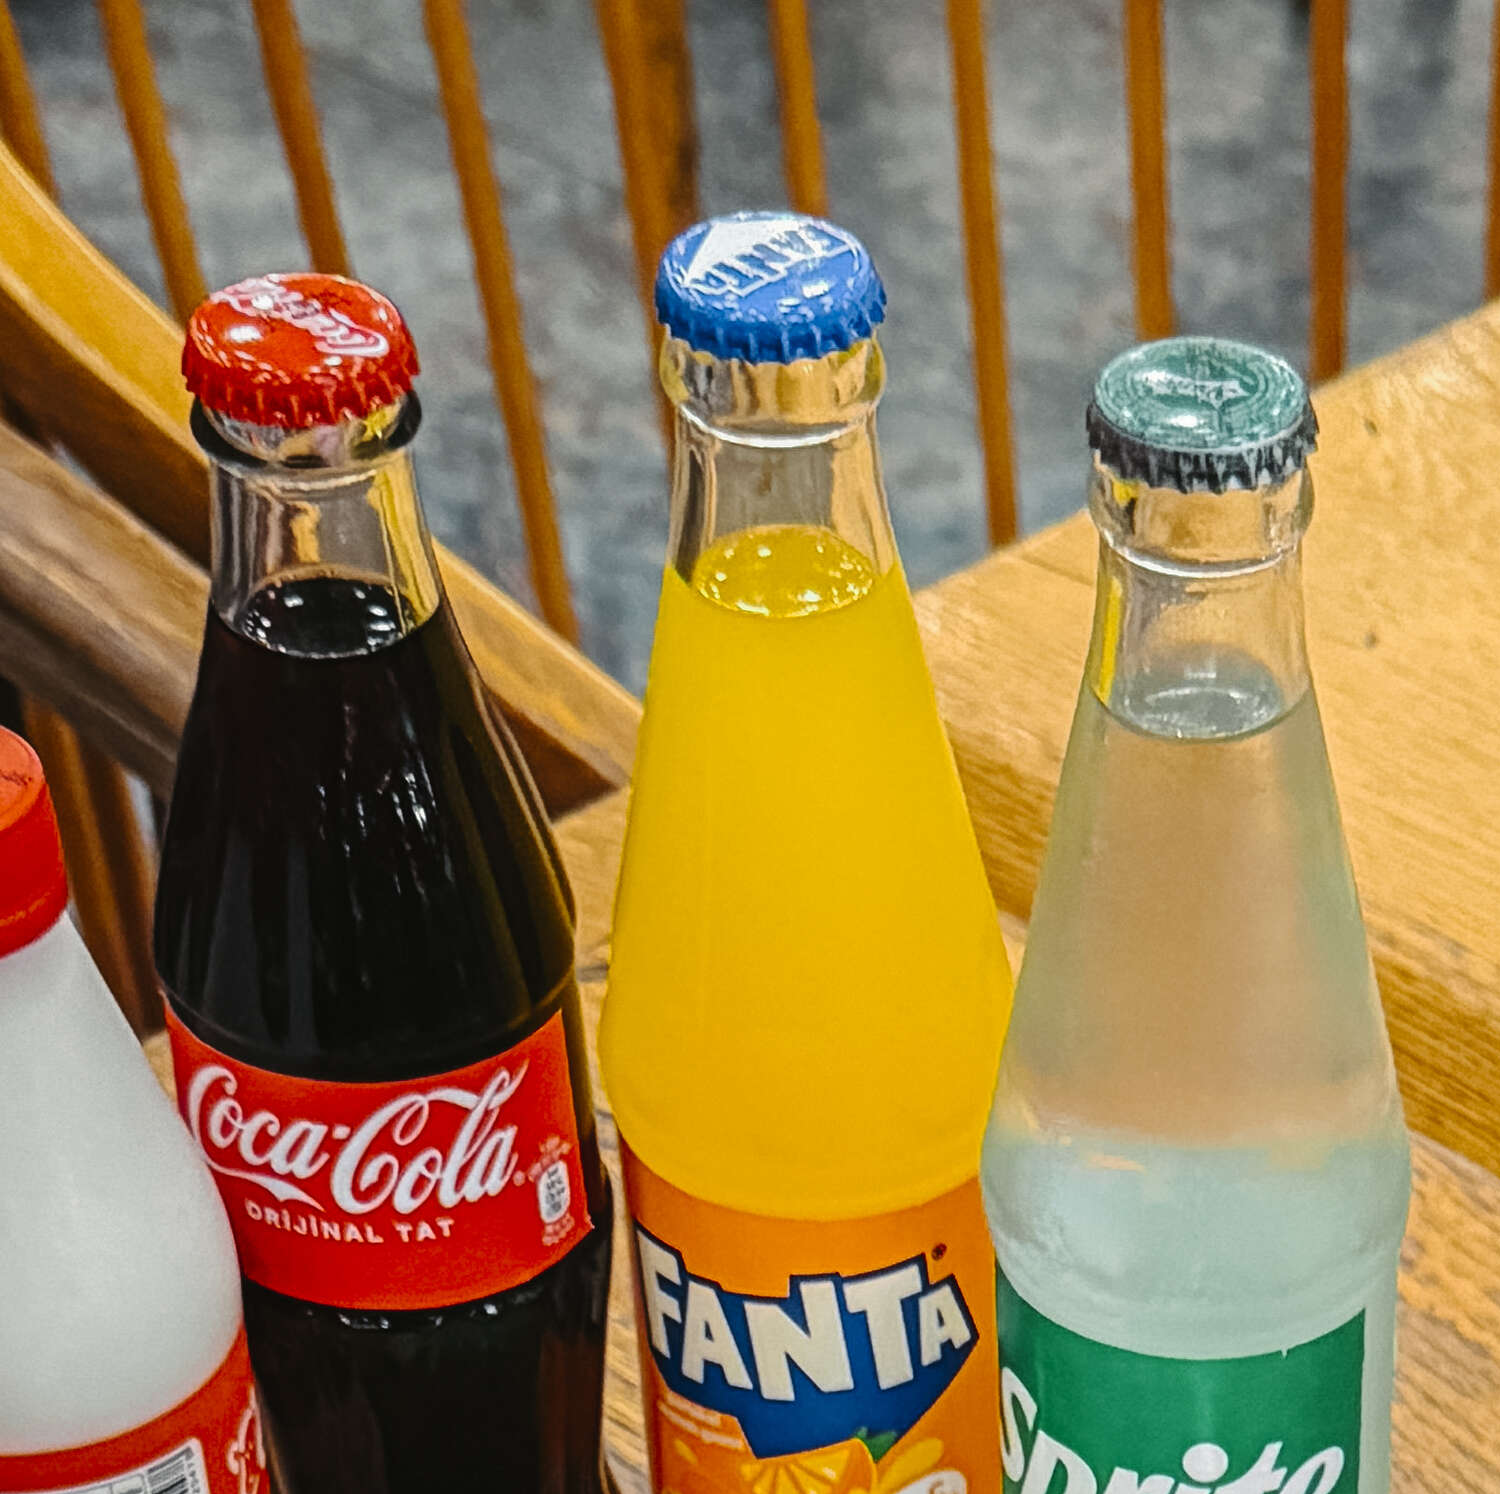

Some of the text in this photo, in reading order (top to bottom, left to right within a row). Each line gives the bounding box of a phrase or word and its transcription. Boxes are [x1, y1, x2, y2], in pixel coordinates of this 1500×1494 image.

[188, 1058, 529, 1216] Coca-Cola
[396, 1217, 455, 1243] TAT
[636, 1230, 974, 1403] FANTA
